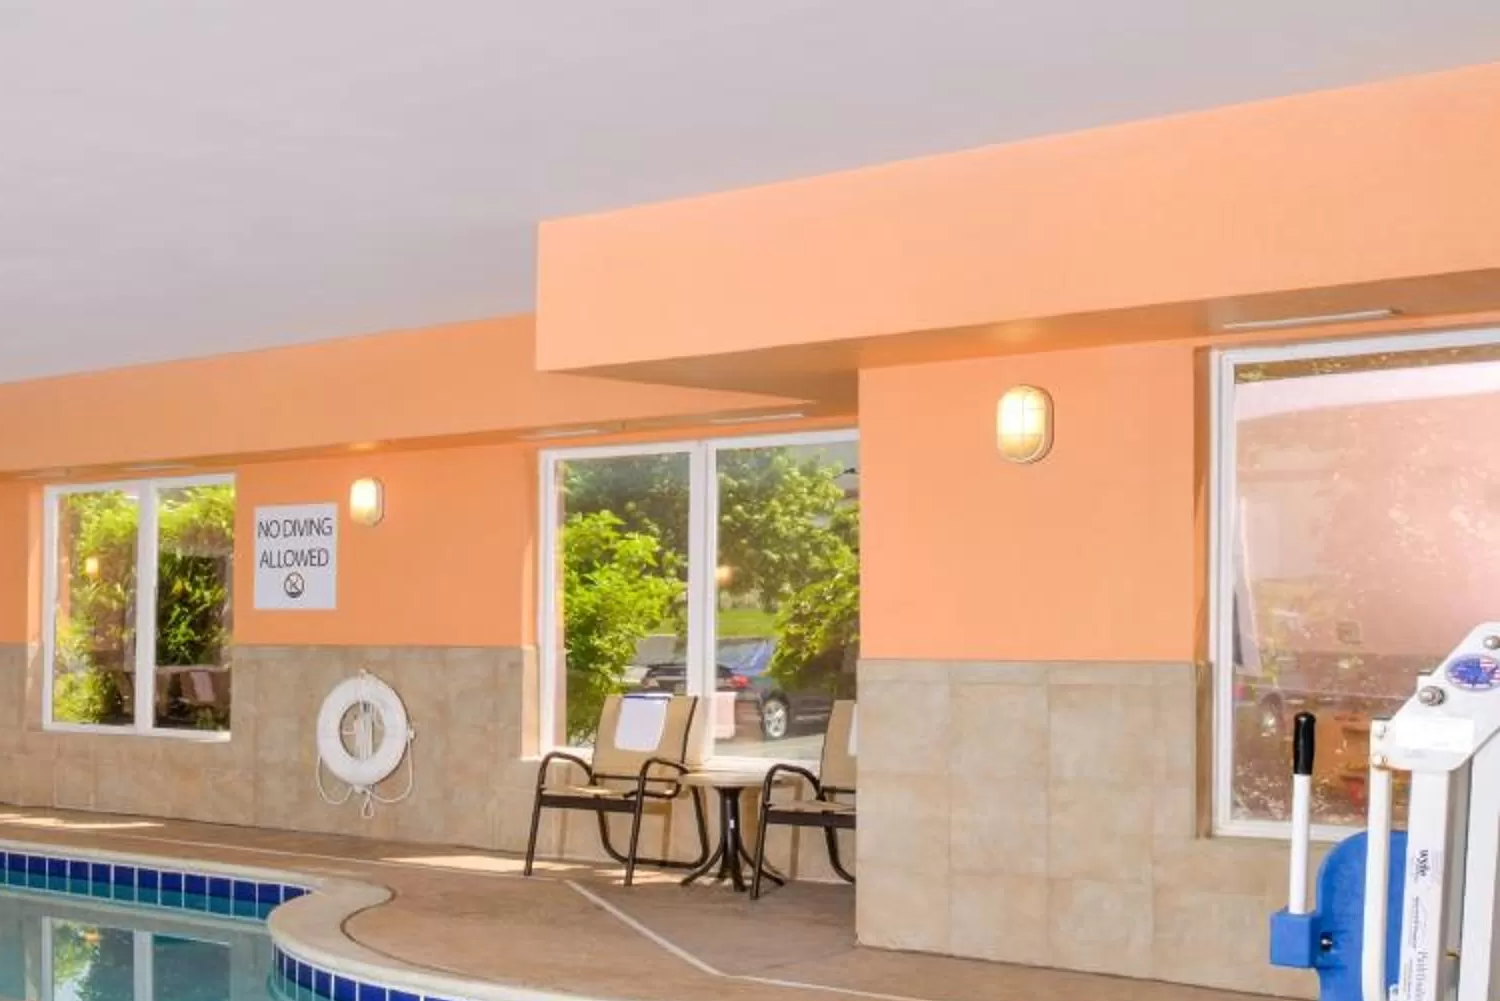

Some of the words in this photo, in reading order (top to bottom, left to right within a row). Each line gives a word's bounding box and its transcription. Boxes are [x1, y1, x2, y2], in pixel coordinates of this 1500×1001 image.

[258, 519, 280, 539] NO
[283, 517, 333, 538] DIVING
[259, 547, 329, 569] ALLOWED
